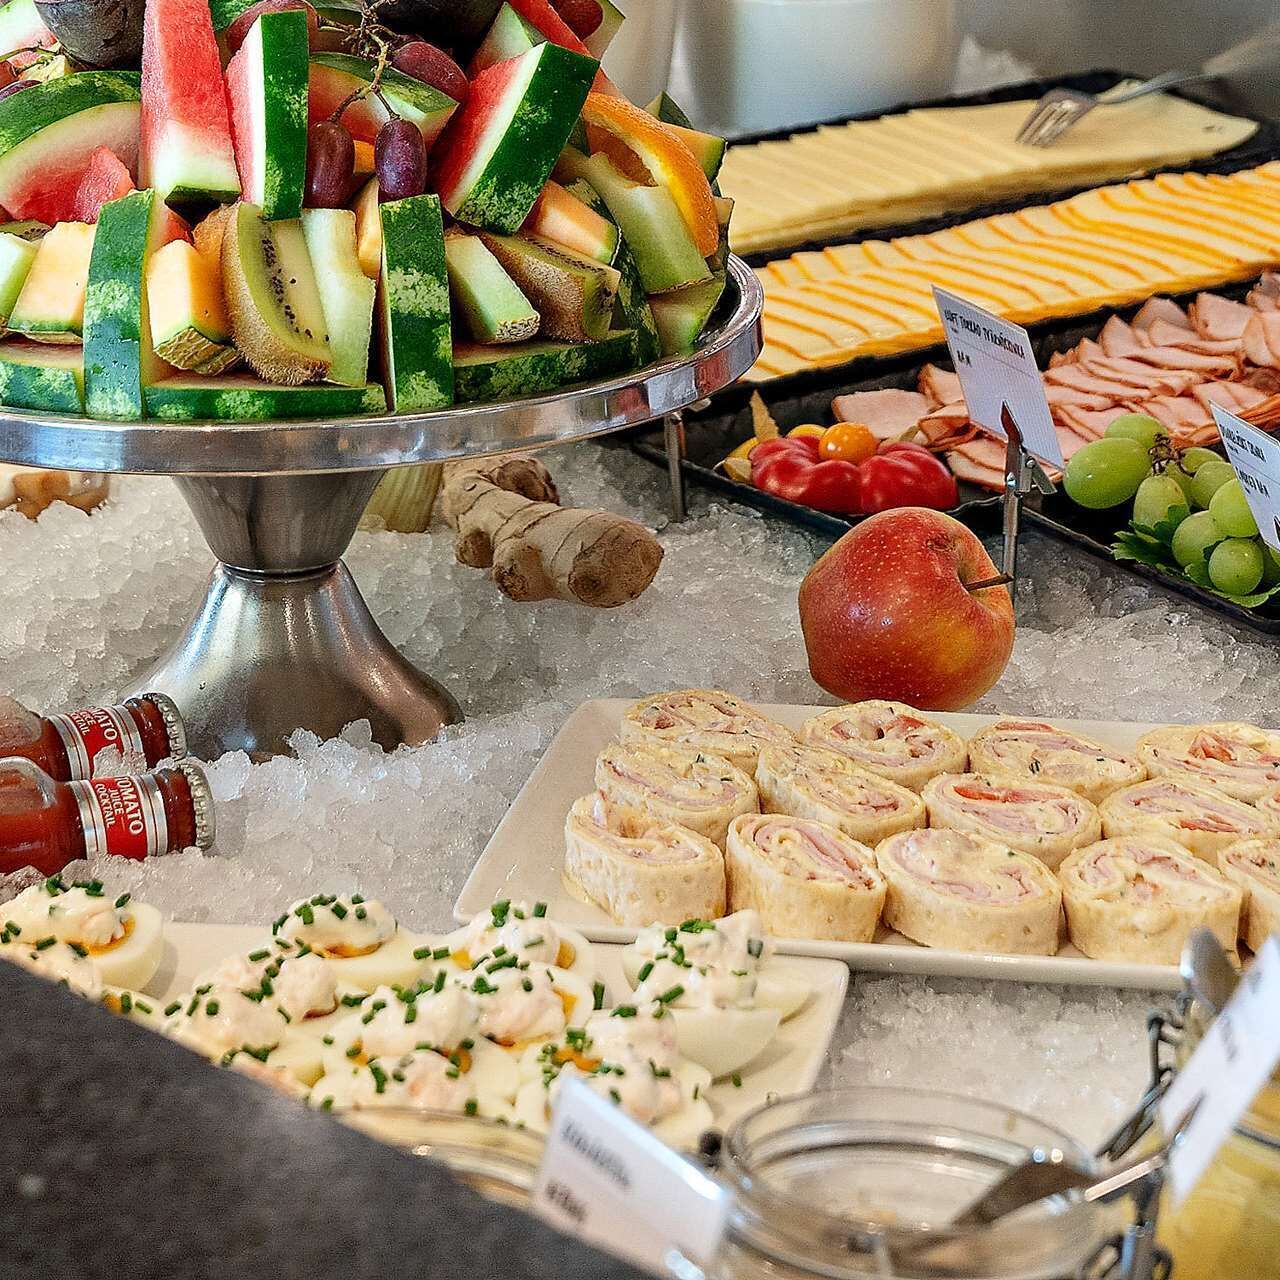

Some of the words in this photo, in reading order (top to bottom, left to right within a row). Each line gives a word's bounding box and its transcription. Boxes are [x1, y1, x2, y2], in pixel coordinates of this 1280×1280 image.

[91, 706, 118, 741] MATO
[95, 783, 116, 828] COCKTAIL
[108, 788, 125, 815] JUICE
[115, 775, 144, 835] TOMATO
